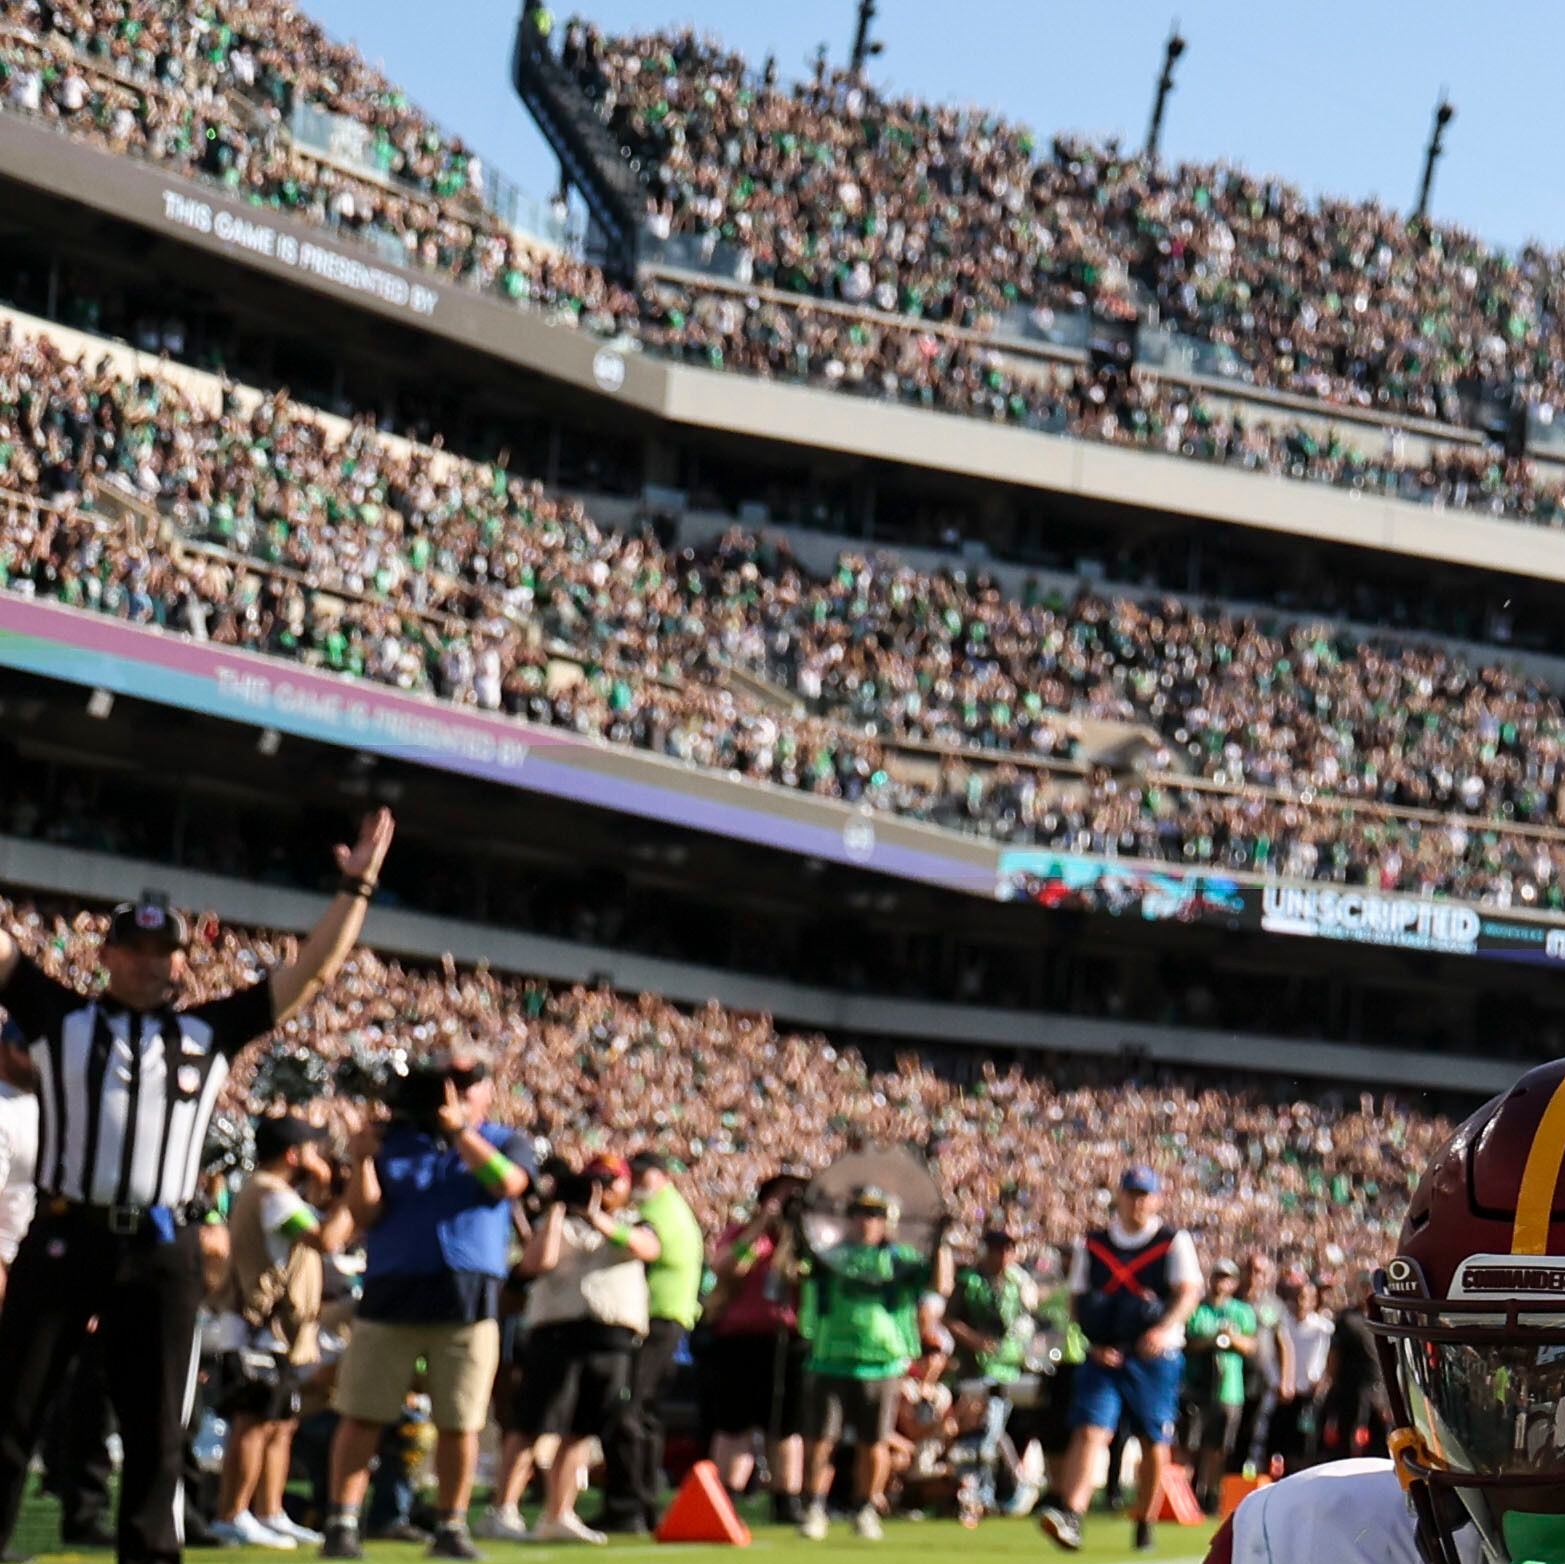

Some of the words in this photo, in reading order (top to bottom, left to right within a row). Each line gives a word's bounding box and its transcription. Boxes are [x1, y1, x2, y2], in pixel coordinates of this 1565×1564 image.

[162, 189, 213, 233] THIS
[213, 211, 277, 257] GAME
[275, 232, 300, 266] IS
[409, 283, 439, 316] BY
[1262, 885, 1481, 944] UNSCRIPTED
